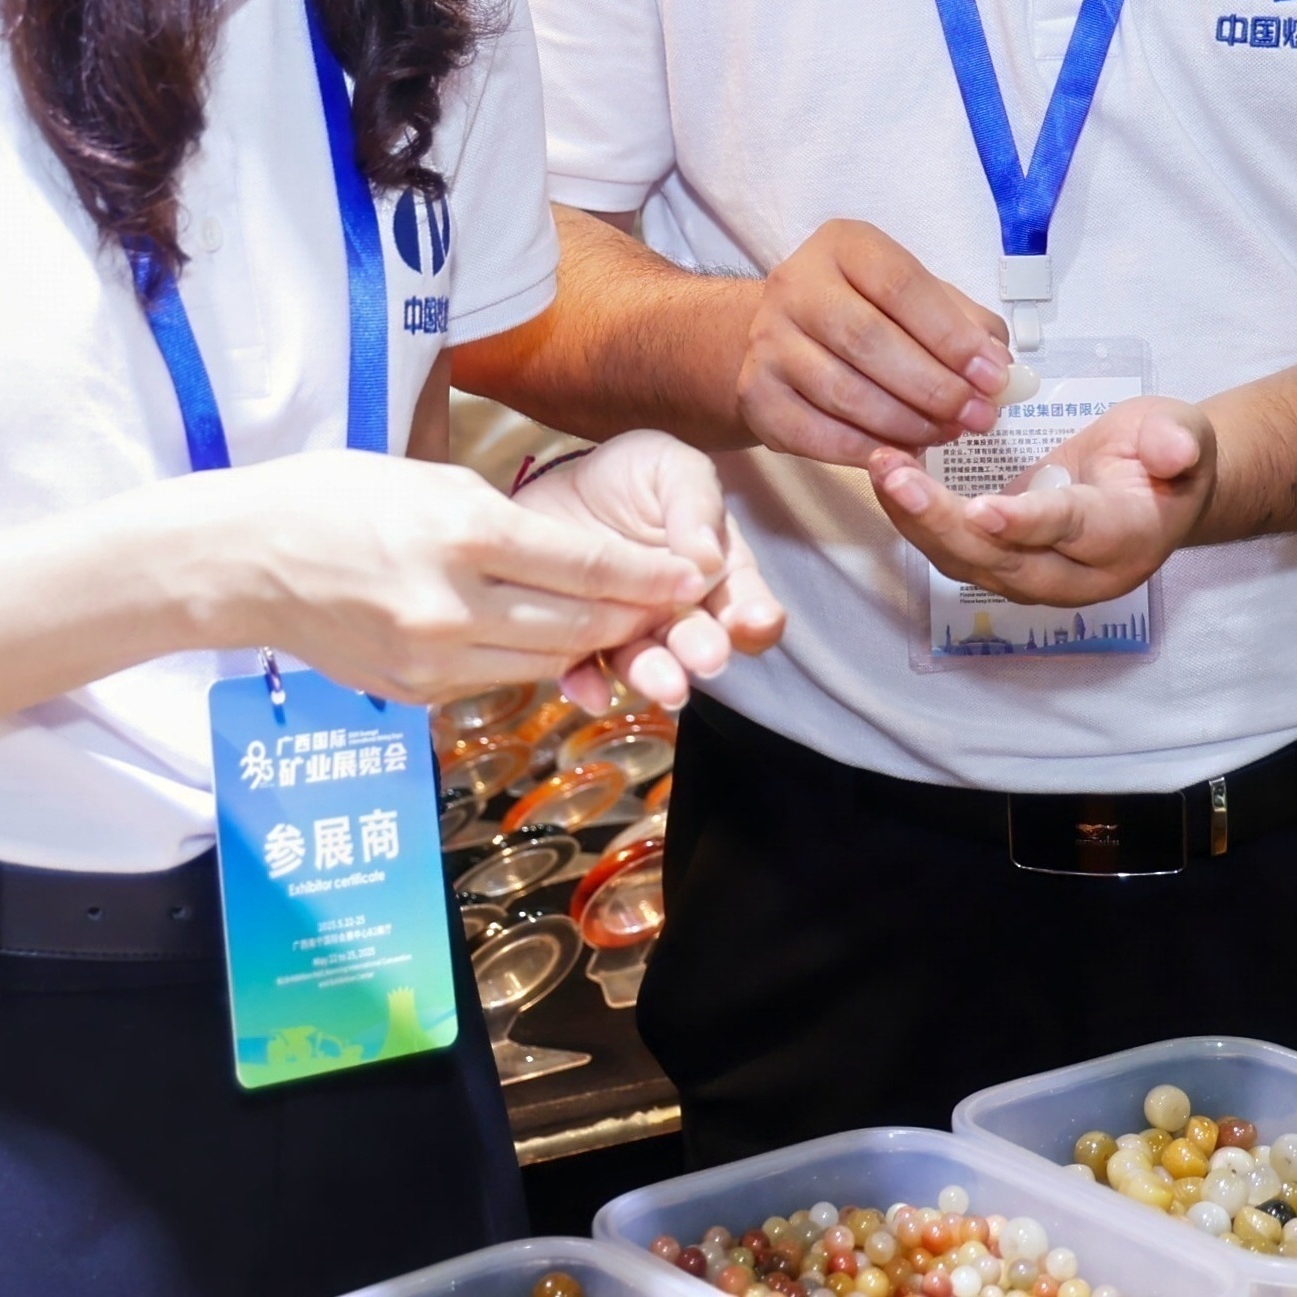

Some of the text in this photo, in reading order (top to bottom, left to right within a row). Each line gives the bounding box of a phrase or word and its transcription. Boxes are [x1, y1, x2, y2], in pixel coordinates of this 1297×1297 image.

[276, 728, 347, 757] 广西国际
[279, 742, 408, 787] 矿业展览会
[264, 808, 400, 880] 参展商
[289, 870, 386, 897] Exhibitor certificate
